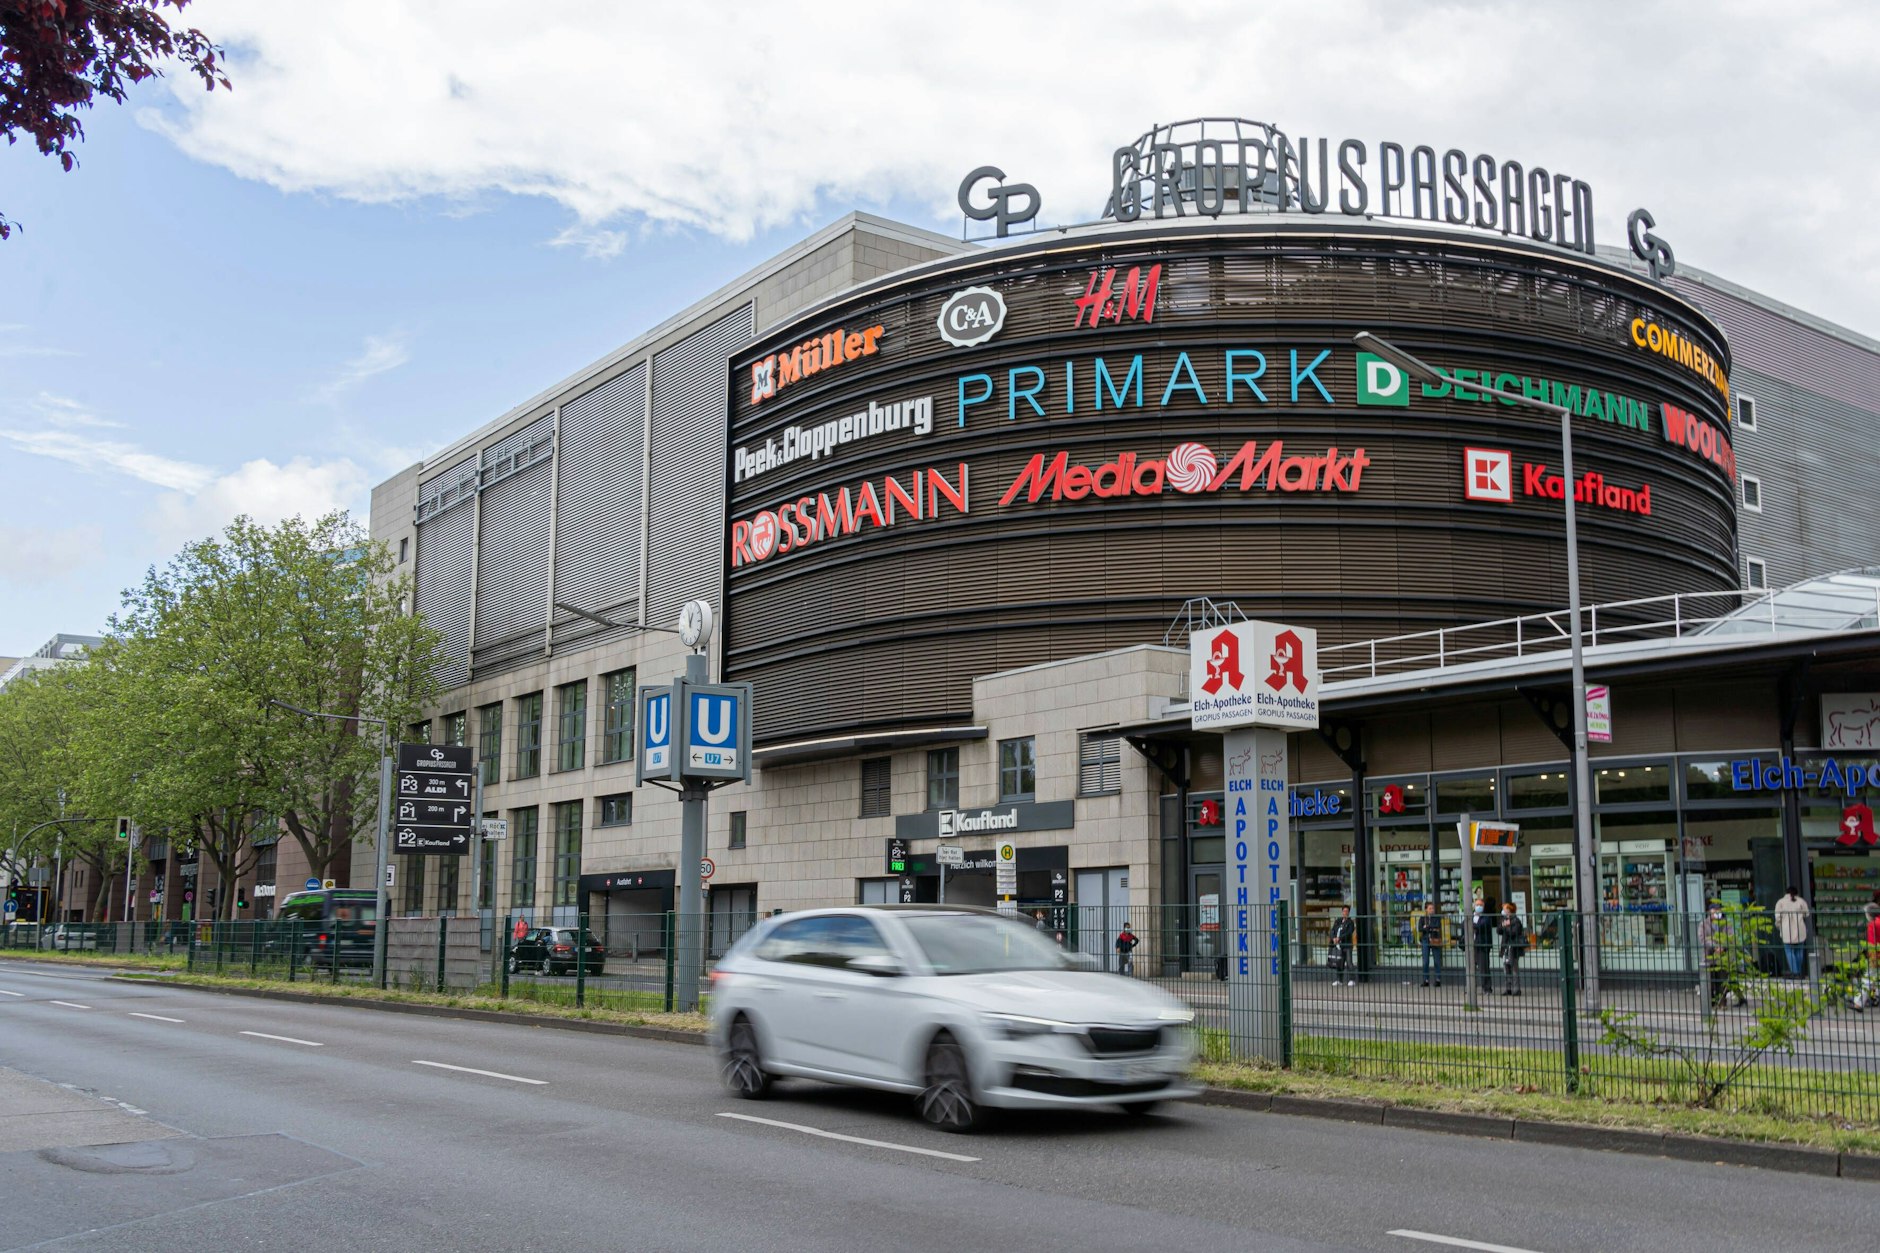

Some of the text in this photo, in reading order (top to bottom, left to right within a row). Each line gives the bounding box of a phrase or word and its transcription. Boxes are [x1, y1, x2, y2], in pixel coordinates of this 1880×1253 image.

[1074, 264, 1162, 329] H&M
[949, 301, 995, 331] C&A
[777, 324, 886, 391] Müller
[958, 349, 1335, 428] PRIMARK
[1421, 366, 1649, 431] DEICHMANN
[999, 440, 1371, 506] Media Markt
[1523, 463, 1652, 516] Kaufland
[731, 463, 969, 568] ROSSMANN
[1194, 694, 1252, 711] Elch-Apotheke
[1257, 693, 1316, 710] Elch-Apotheke
[650, 697, 668, 744] U
[697, 698, 731, 745] U
[1194, 708, 1253, 723] GROPIUS PASSAGEN
[1257, 708, 1317, 721] GROPIUS PASSAGEN
[653, 752, 662, 764] U7
[705, 754, 721, 764] U7
[401, 778, 418, 791] P3
[424, 786, 447, 794] ALDI
[1229, 779, 1252, 792] ELCH
[1260, 778, 1284, 792] ELCH
[400, 805, 415, 818] P1
[956, 808, 1018, 832] Kaufland
[398, 832, 417, 845] P2
[424, 839, 450, 847] Kaufland
[701, 863, 712, 874] 50
[1054, 889, 1063, 899] P2
[1235, 797, 1249, 975] APOTHEKE
[903, 894, 912, 903] P2
